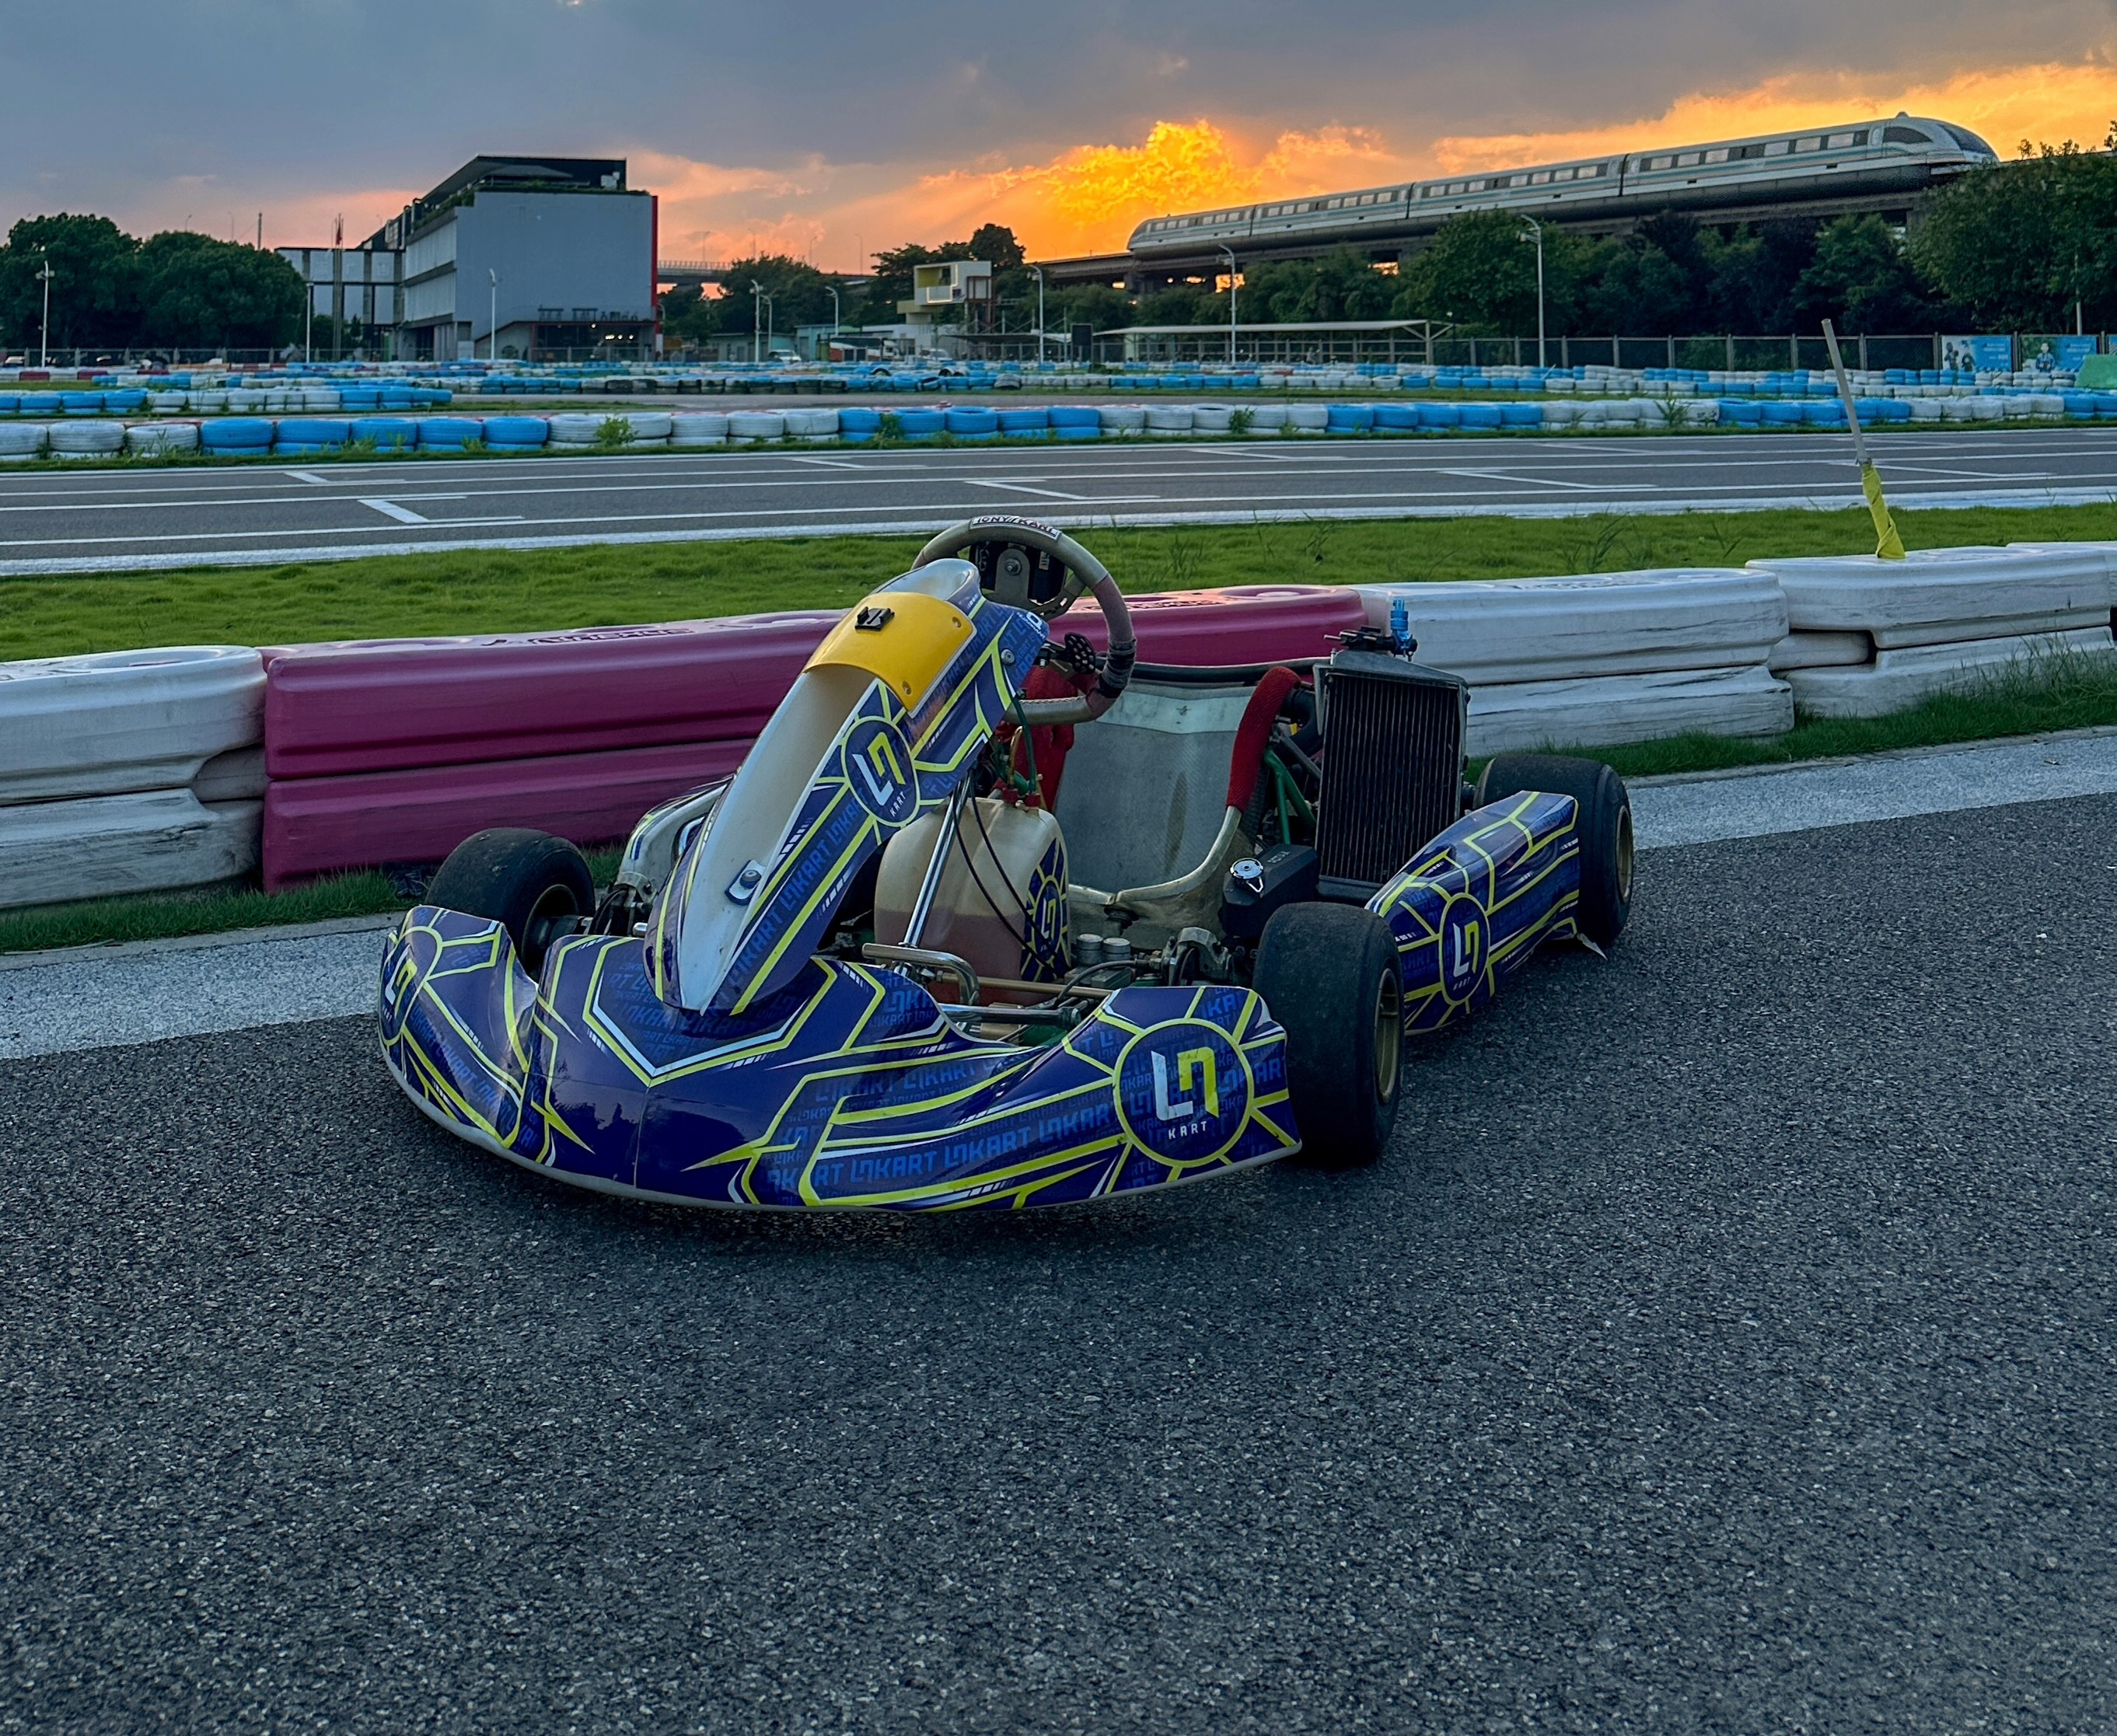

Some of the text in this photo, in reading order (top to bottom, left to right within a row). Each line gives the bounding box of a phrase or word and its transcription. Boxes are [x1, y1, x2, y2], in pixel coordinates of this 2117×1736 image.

[1026, 612, 1043, 630] Q
[889, 791, 907, 817] KART
[1151, 1046, 1220, 1121] LN
[1168, 1120, 1208, 1140] KART
